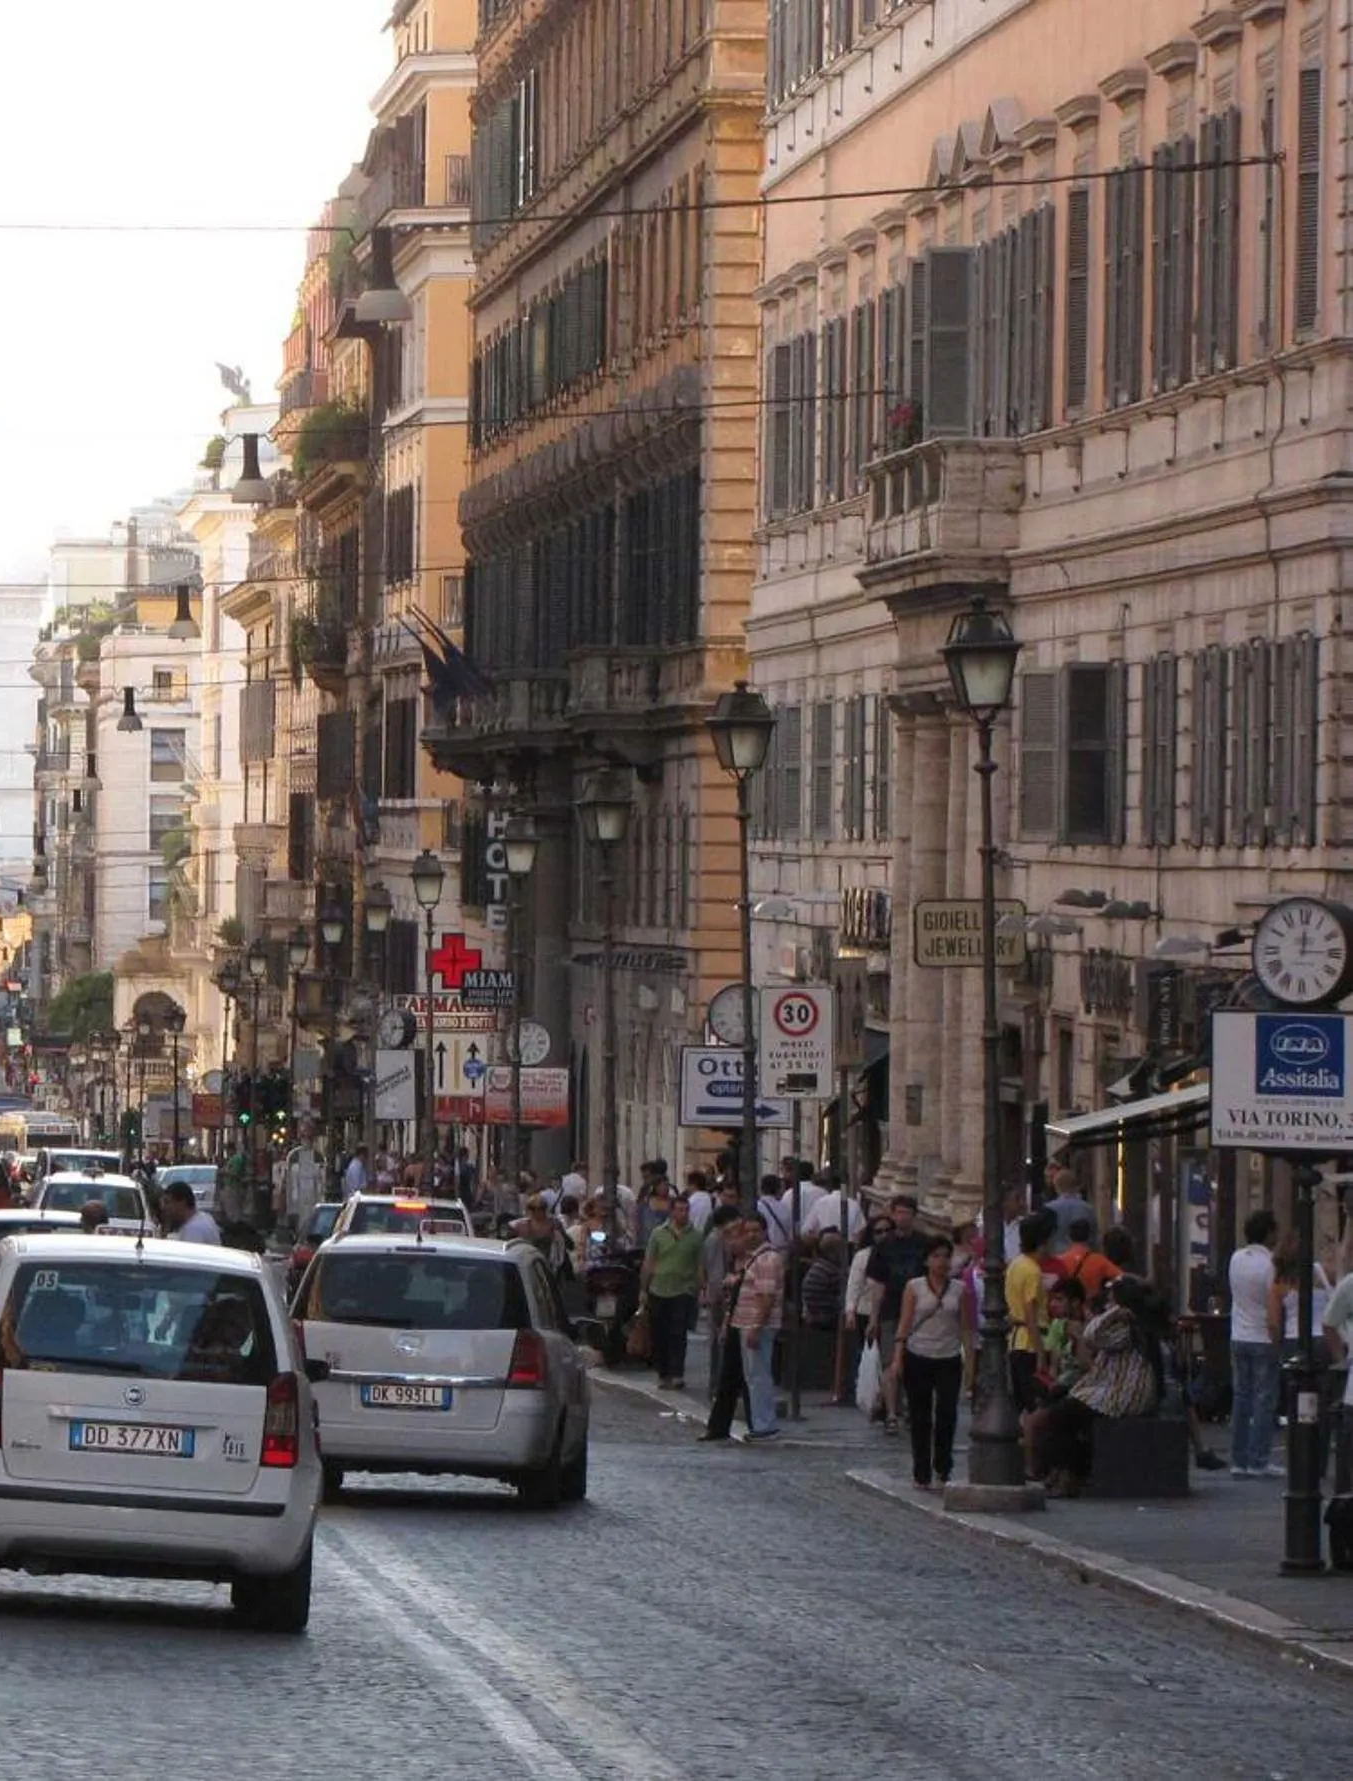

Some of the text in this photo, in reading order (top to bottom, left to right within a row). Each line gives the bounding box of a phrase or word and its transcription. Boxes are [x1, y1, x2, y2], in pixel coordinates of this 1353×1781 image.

[924, 936, 1016, 957] JEWELLRY
[783, 1004, 810, 1023] 30
[1259, 1067, 1340, 1089] Assitalia
[1228, 1109, 1259, 1125] VIA
[1264, 1110, 1343, 1129] TORINO,
[37, 1272, 56, 1288] 05
[84, 1425, 180, 1450] DD 377XN
